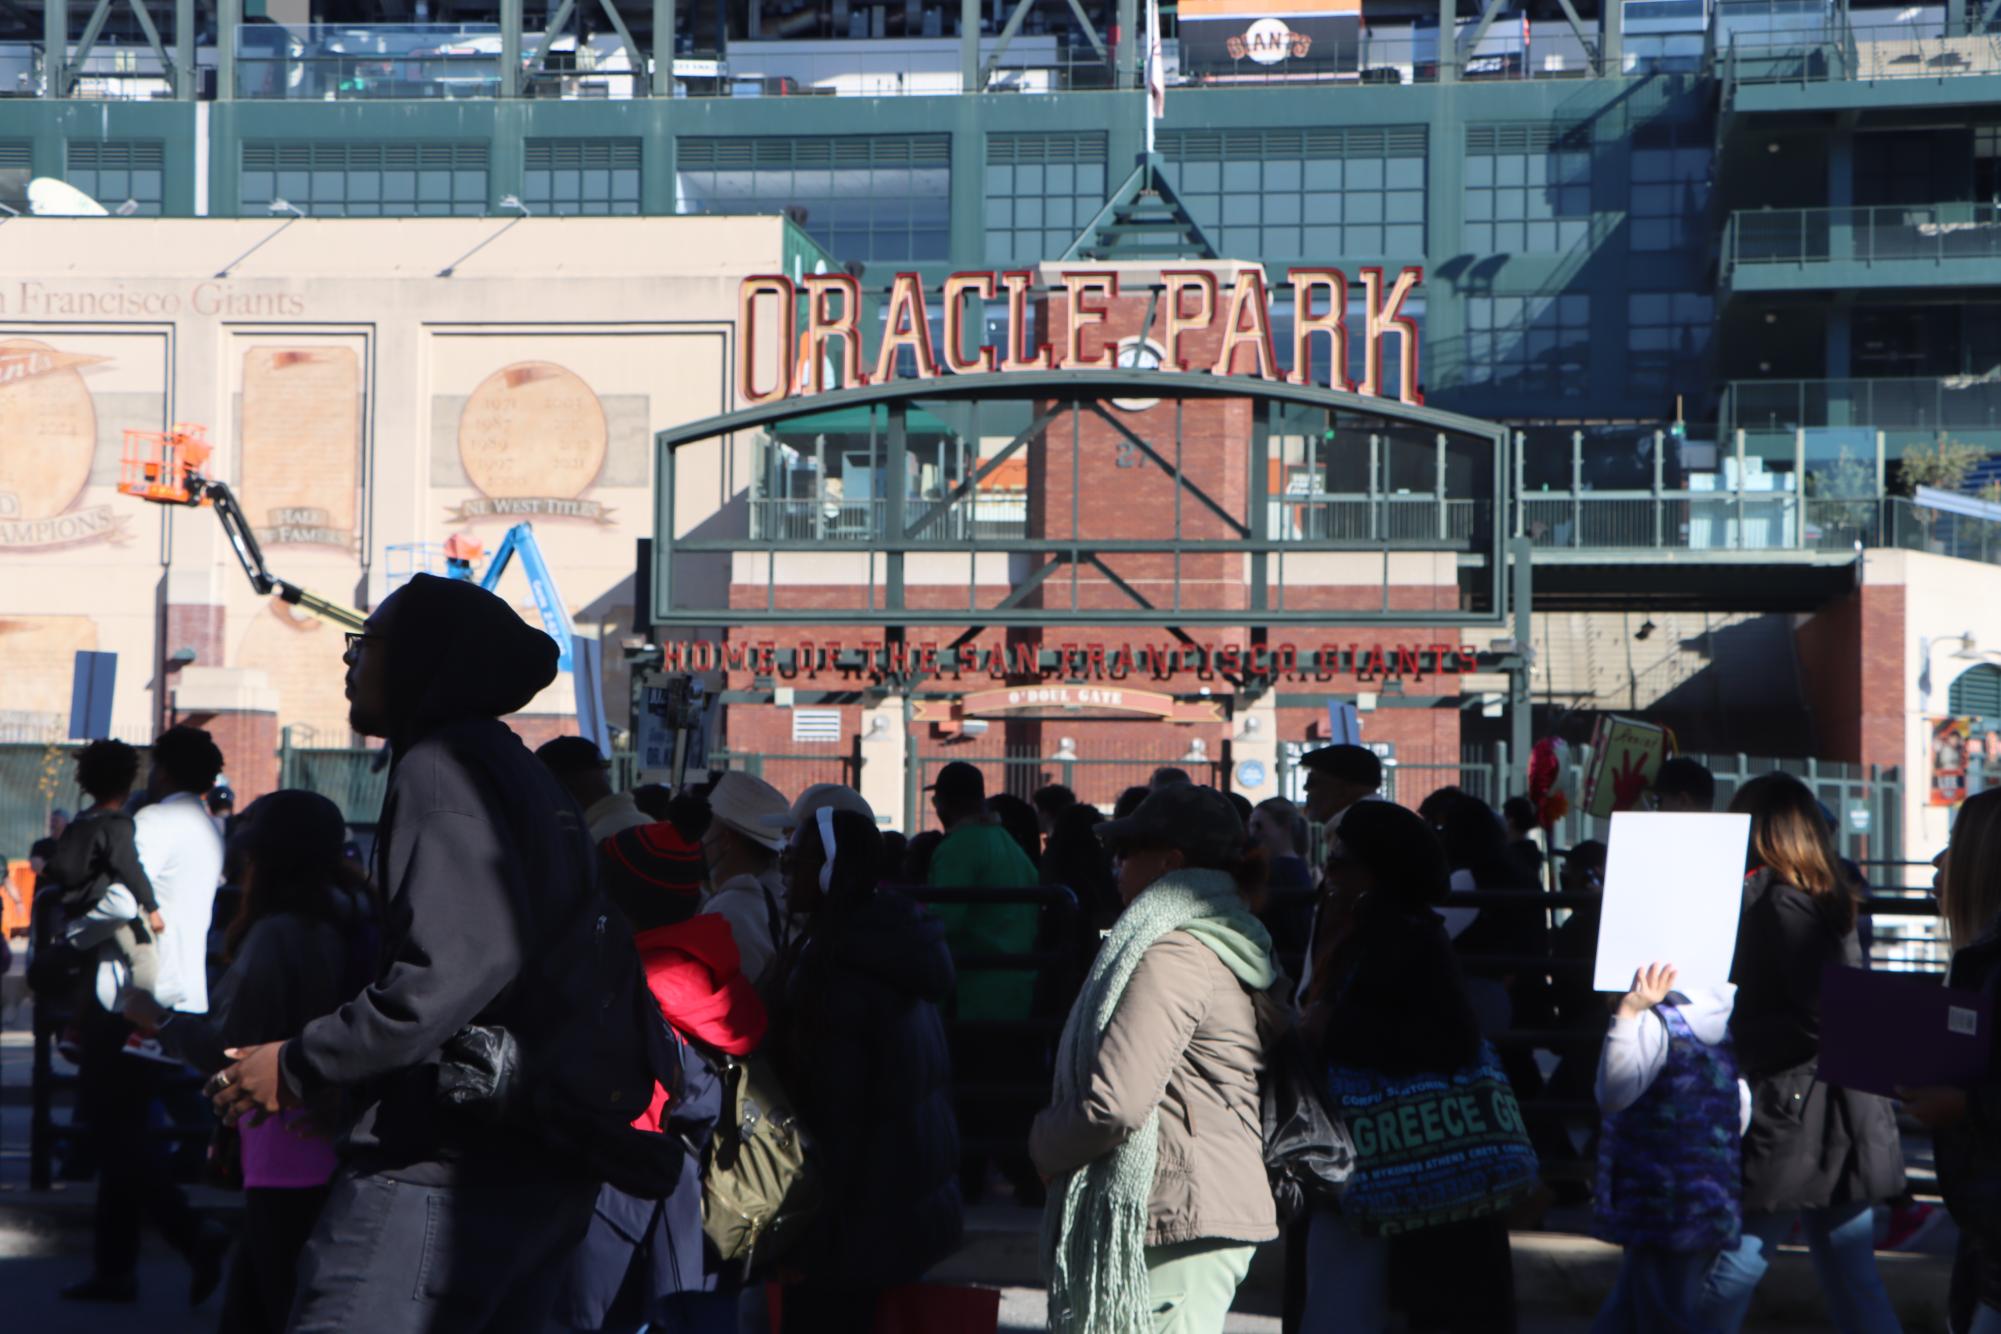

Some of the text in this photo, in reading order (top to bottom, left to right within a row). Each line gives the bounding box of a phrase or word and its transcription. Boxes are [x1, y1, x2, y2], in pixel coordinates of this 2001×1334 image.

[19, 281, 181, 315] Francisco
[191, 281, 305, 316] Giants
[737, 266, 1425, 407] ORACLE PARK
[662, 640, 1478, 675] HOME OF THE SAN FRANCISCO GIANTS
[1077, 688, 1122, 705] GATE
[1353, 1096, 1487, 1157] GREECE
